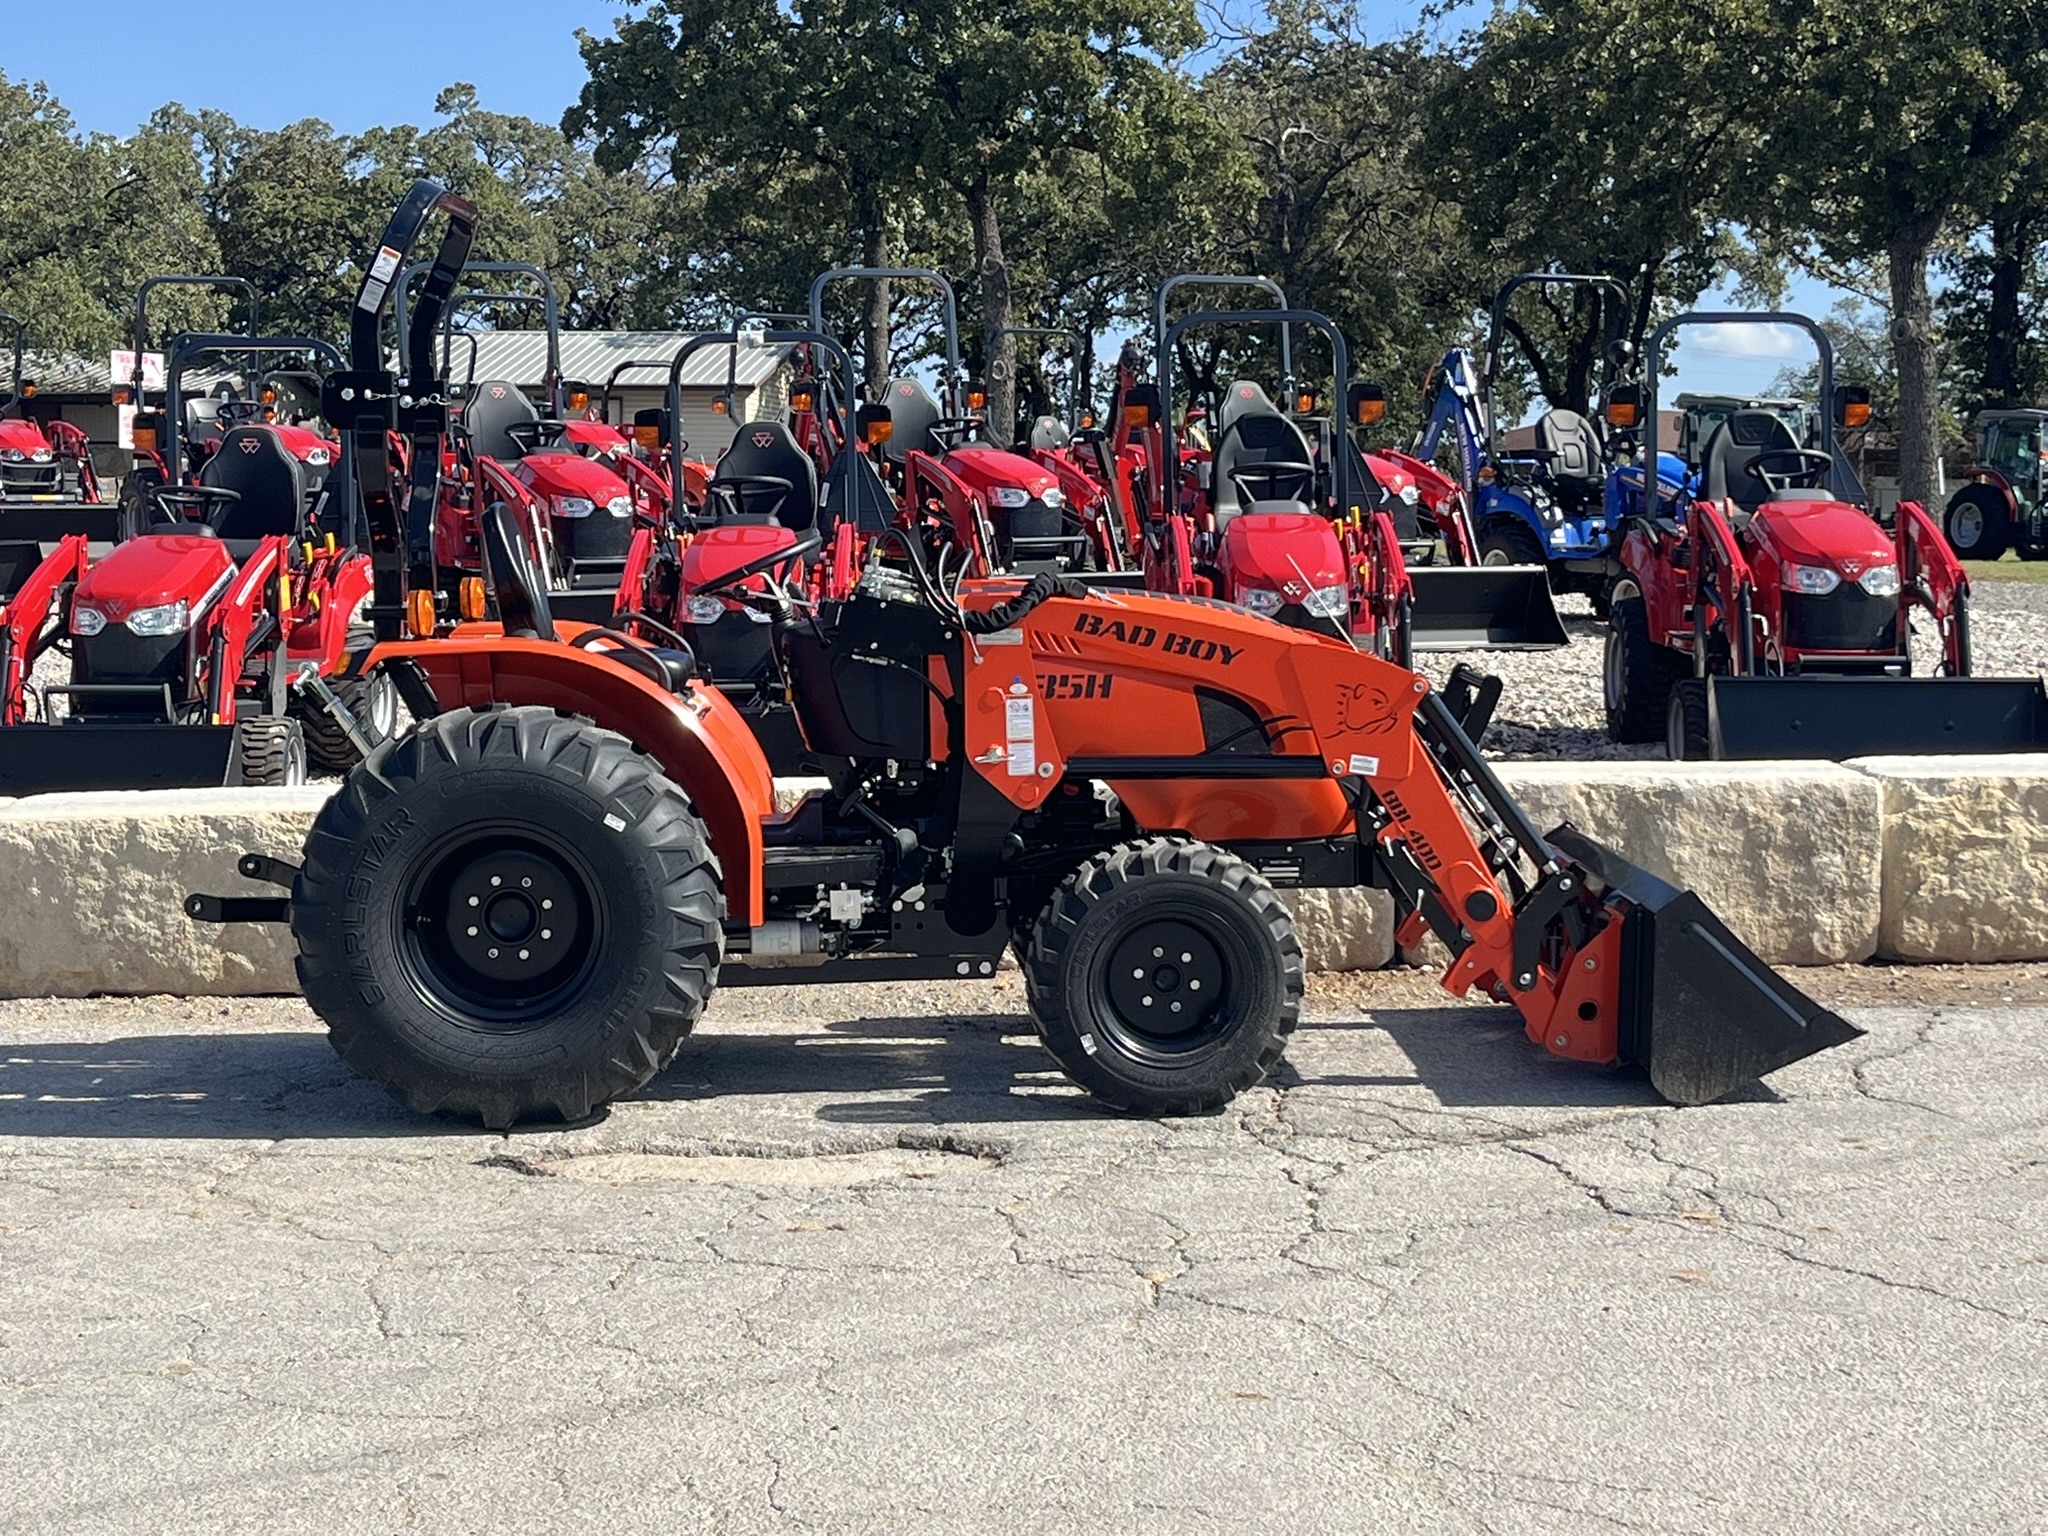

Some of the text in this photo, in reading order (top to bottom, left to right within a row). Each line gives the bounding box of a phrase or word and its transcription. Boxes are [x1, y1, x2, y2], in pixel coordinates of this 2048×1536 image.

[1074, 613, 1246, 665] BAD BOY
[1381, 789, 1443, 871] BBL 400
[342, 807, 417, 1006] CARLSTAR
